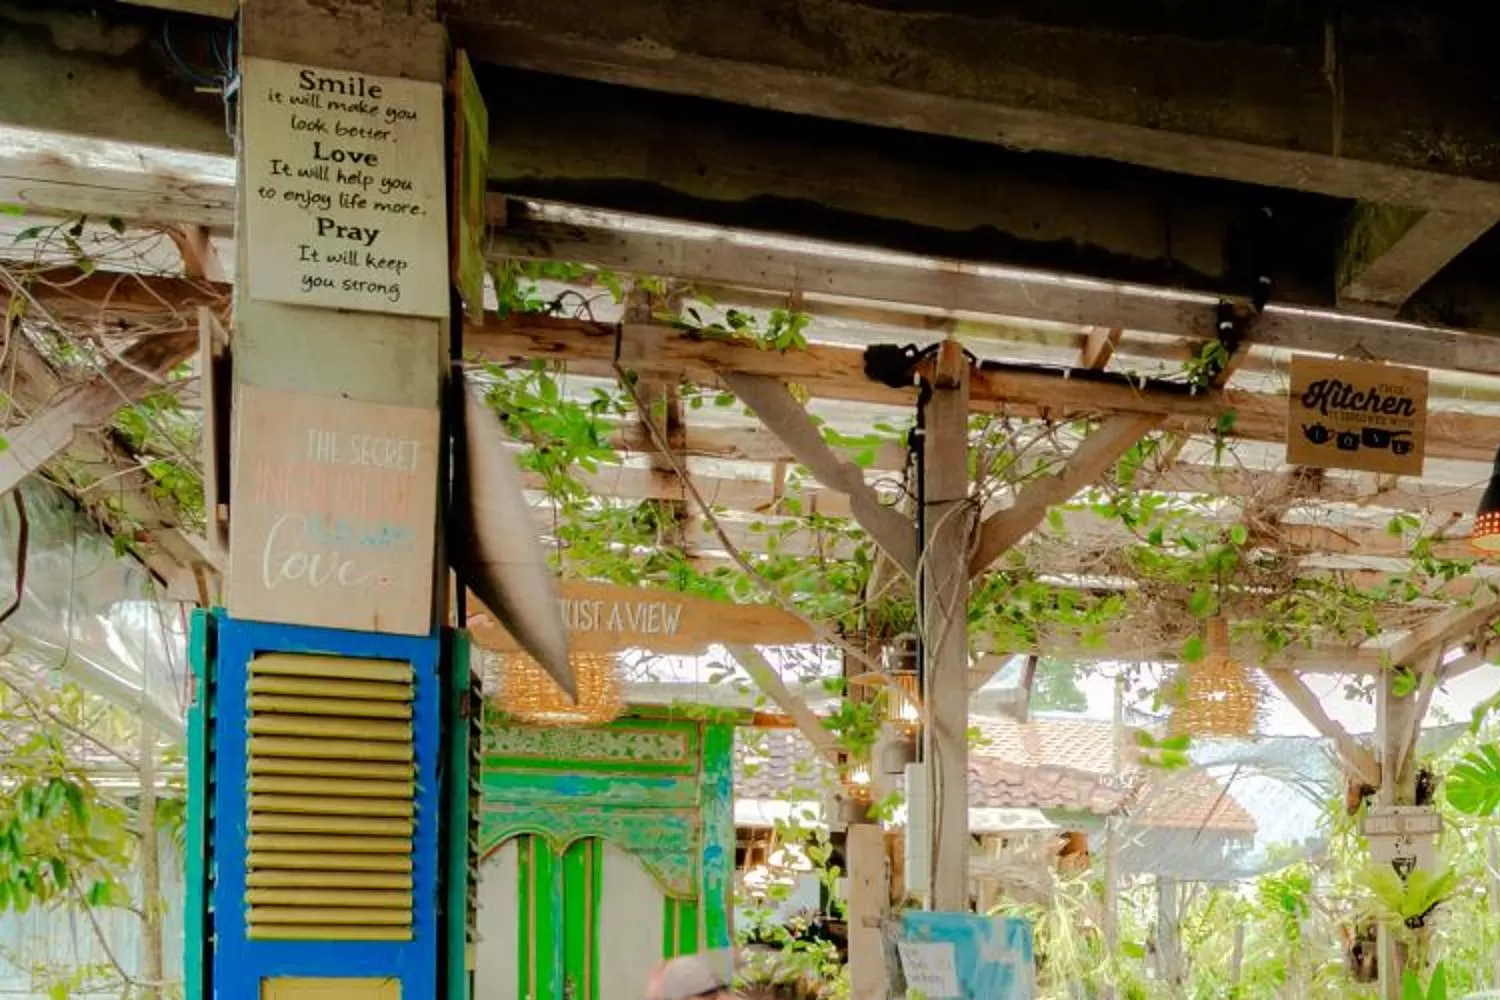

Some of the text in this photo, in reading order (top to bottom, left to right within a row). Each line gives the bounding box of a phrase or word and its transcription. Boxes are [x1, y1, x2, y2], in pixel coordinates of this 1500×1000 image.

[300, 69, 382, 98] Smile
[268, 88, 416, 125] it will make you
[291, 113, 397, 143] look better.
[313, 142, 378, 167] Love
[270, 159, 412, 194] It will help you
[258, 186, 427, 216] to enjoy life more.
[316, 216, 379, 246] Pray
[298, 244, 407, 275] It will keep
[301, 274, 400, 302] you strong
[1302, 378, 1416, 416] Kitchen
[306, 429, 343, 465] THE
[262, 514, 370, 591] Love
[607, 601, 625, 636] A
[625, 601, 682, 637] VIEW
